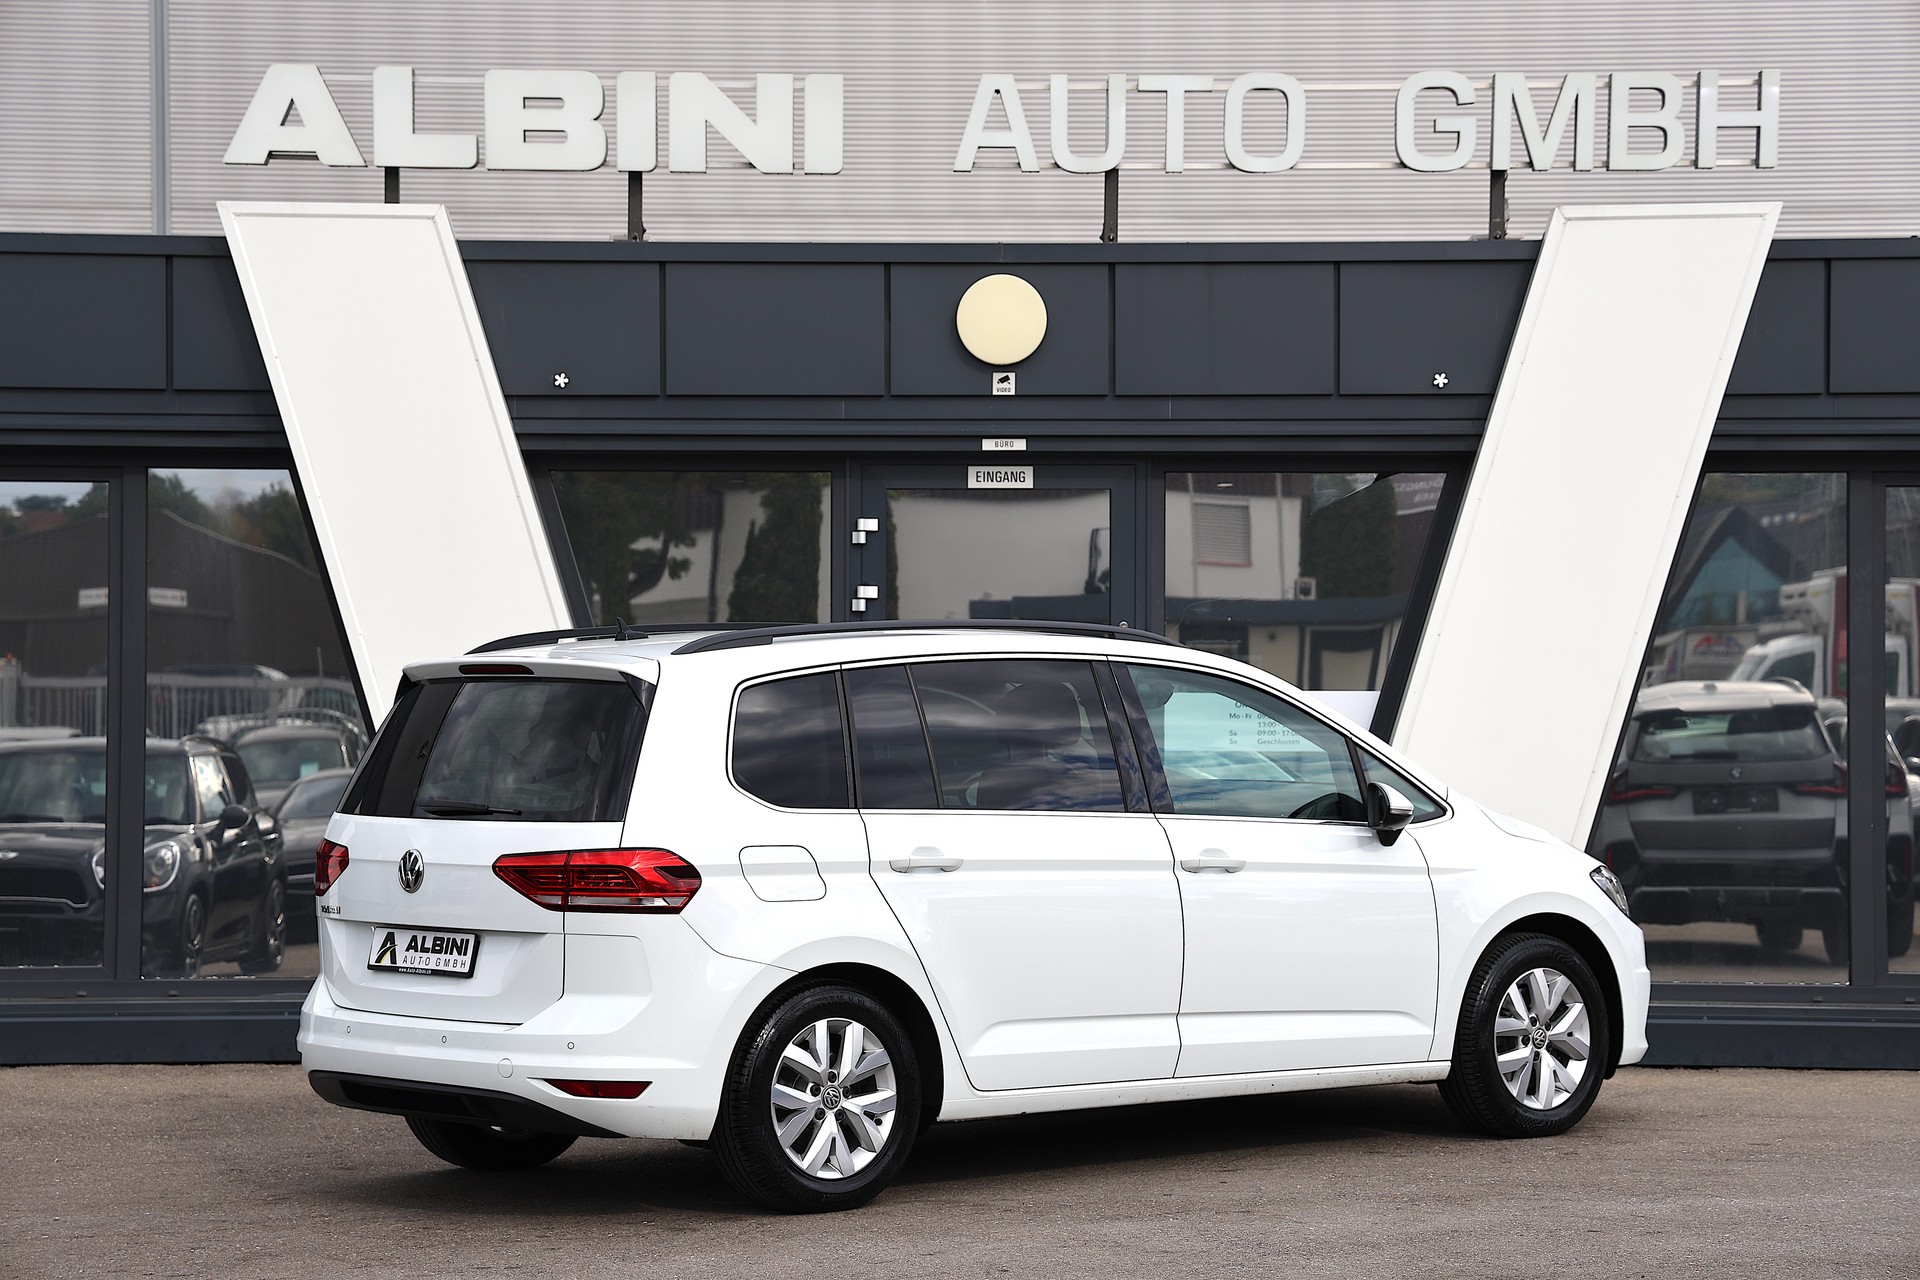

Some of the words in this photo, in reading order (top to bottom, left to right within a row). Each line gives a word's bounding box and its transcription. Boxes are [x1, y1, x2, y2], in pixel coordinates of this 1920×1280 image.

[222, 64, 844, 175] ALBINI
[953, 72, 1307, 174] AUTO
[1395, 69, 1781, 173] GMBH
[994, 440, 1014, 448] BÜRO
[975, 471, 1026, 483] EINGANG
[405, 935, 470, 957] ALBINI
[402, 955, 431, 967] AUTO
[435, 957, 467, 969] GMBH
